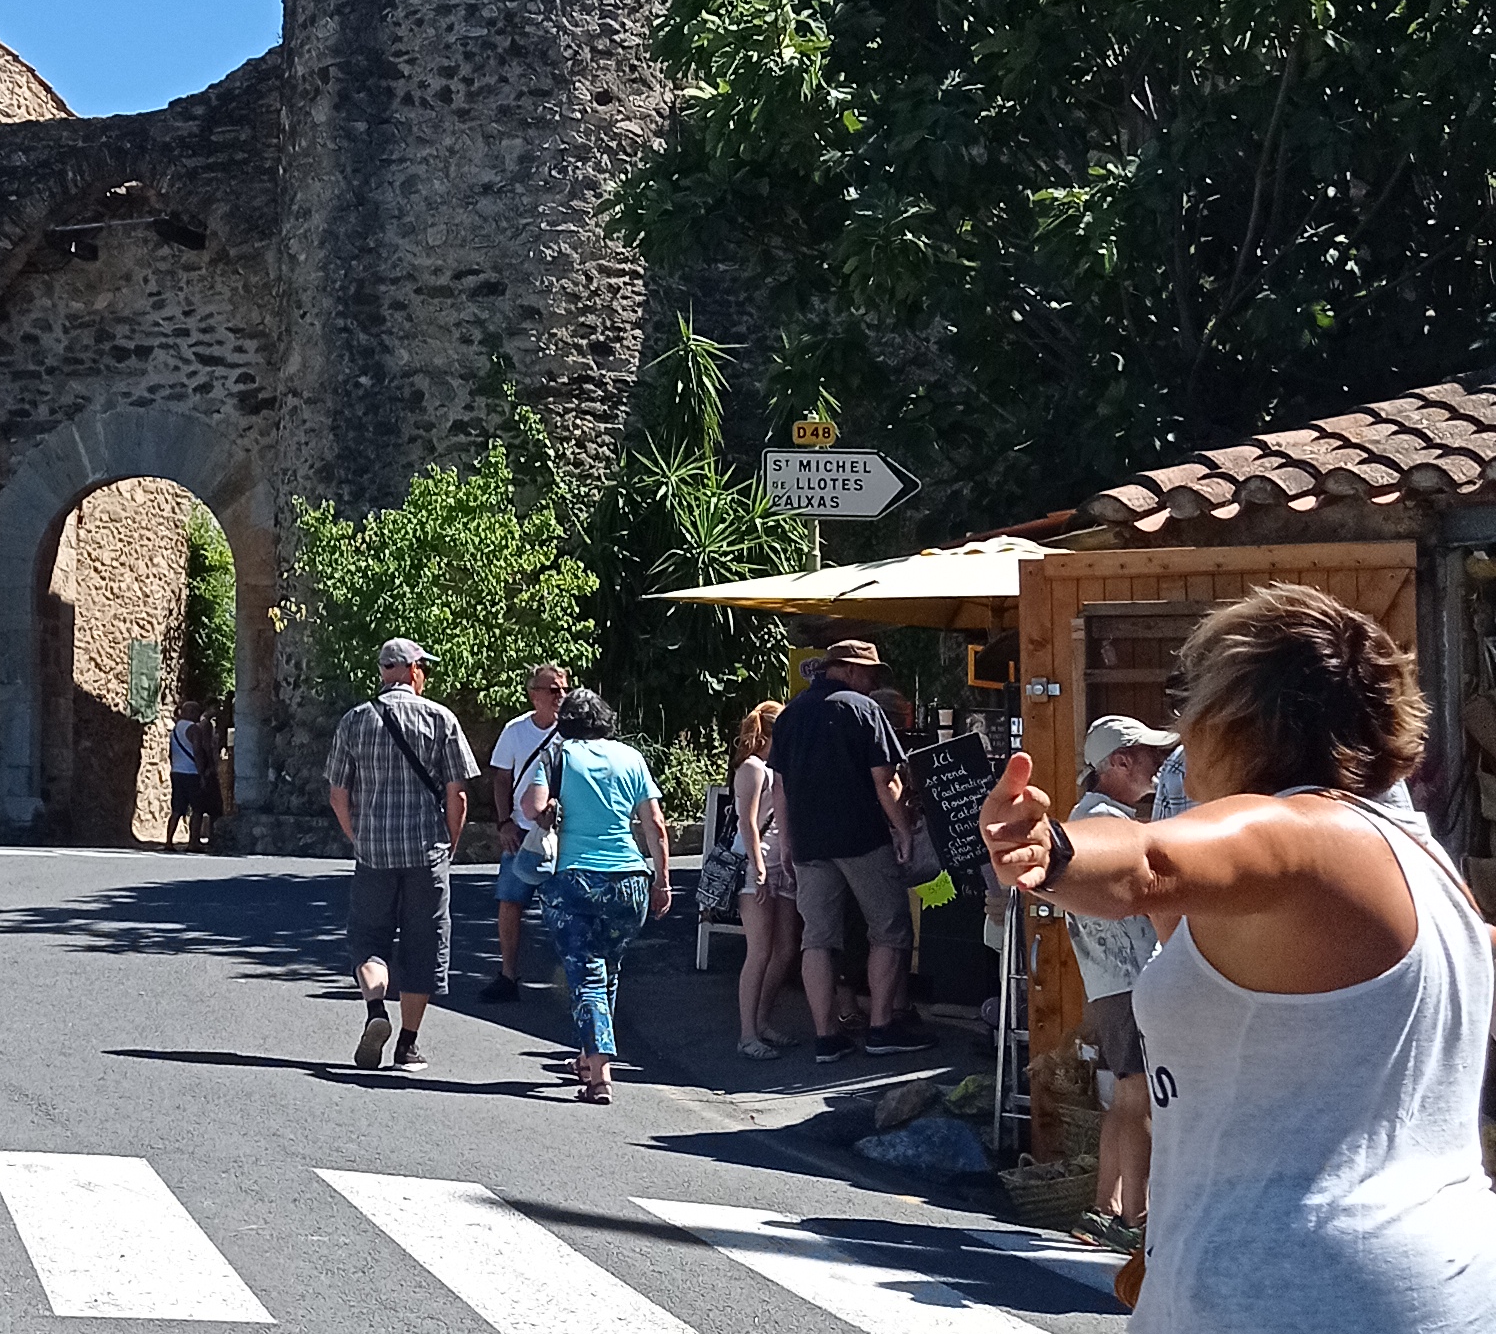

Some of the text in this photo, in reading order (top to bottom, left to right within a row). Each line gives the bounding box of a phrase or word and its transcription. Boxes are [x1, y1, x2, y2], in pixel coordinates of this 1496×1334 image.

[798, 459, 872, 474] MICHEL
[771, 477, 864, 492] DE LLOTES
[772, 494, 840, 509] CAIXAS
[940, 763, 968, 781] vend
